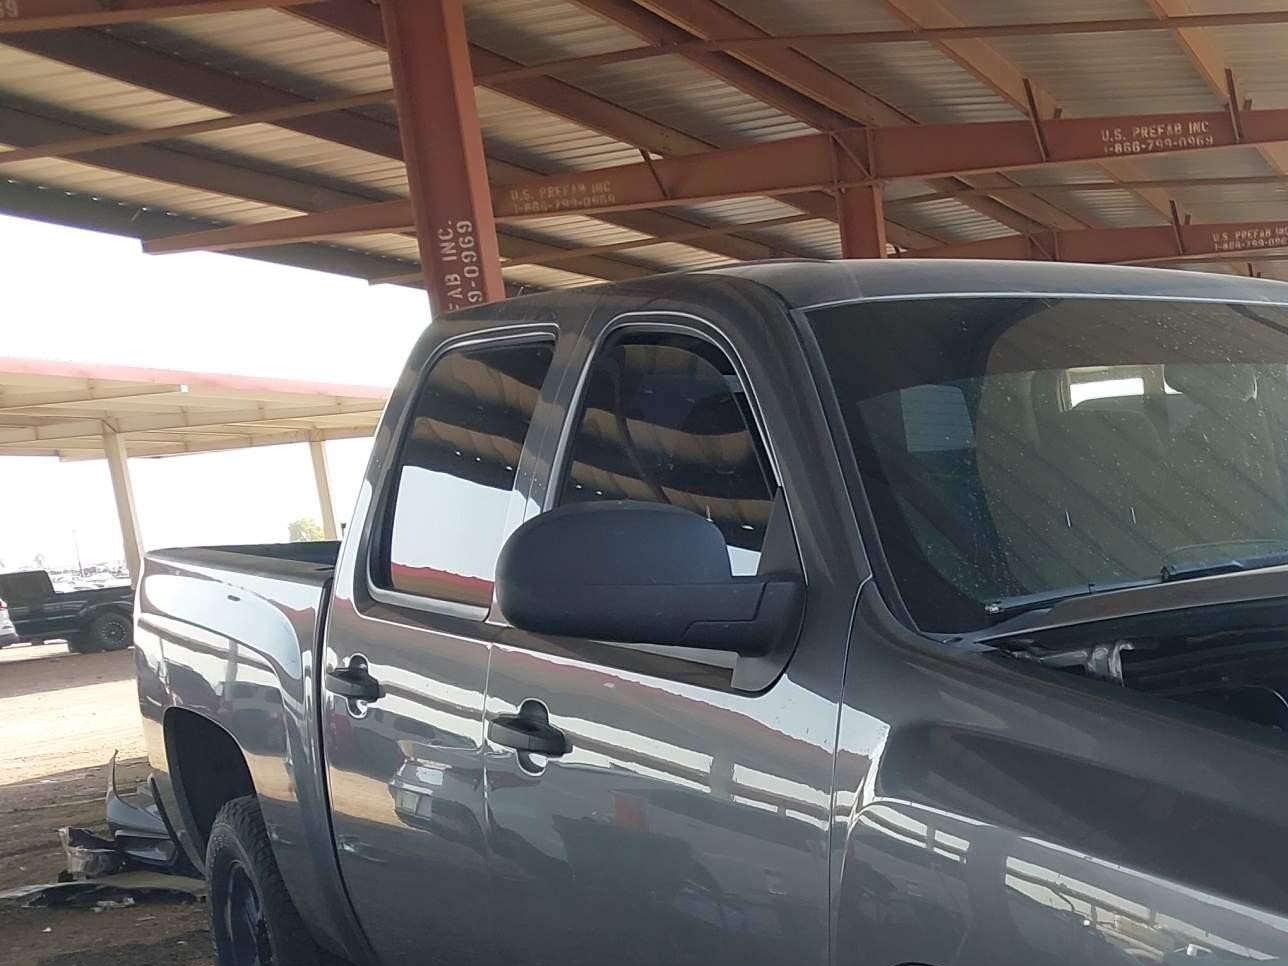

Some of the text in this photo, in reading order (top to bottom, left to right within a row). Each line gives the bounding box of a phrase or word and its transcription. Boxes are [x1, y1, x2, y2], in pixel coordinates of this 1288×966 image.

[1101, 128, 1126, 142] U.S.
[1134, 122, 1182, 140] PREFAB
[438, 220, 457, 261] INC.
